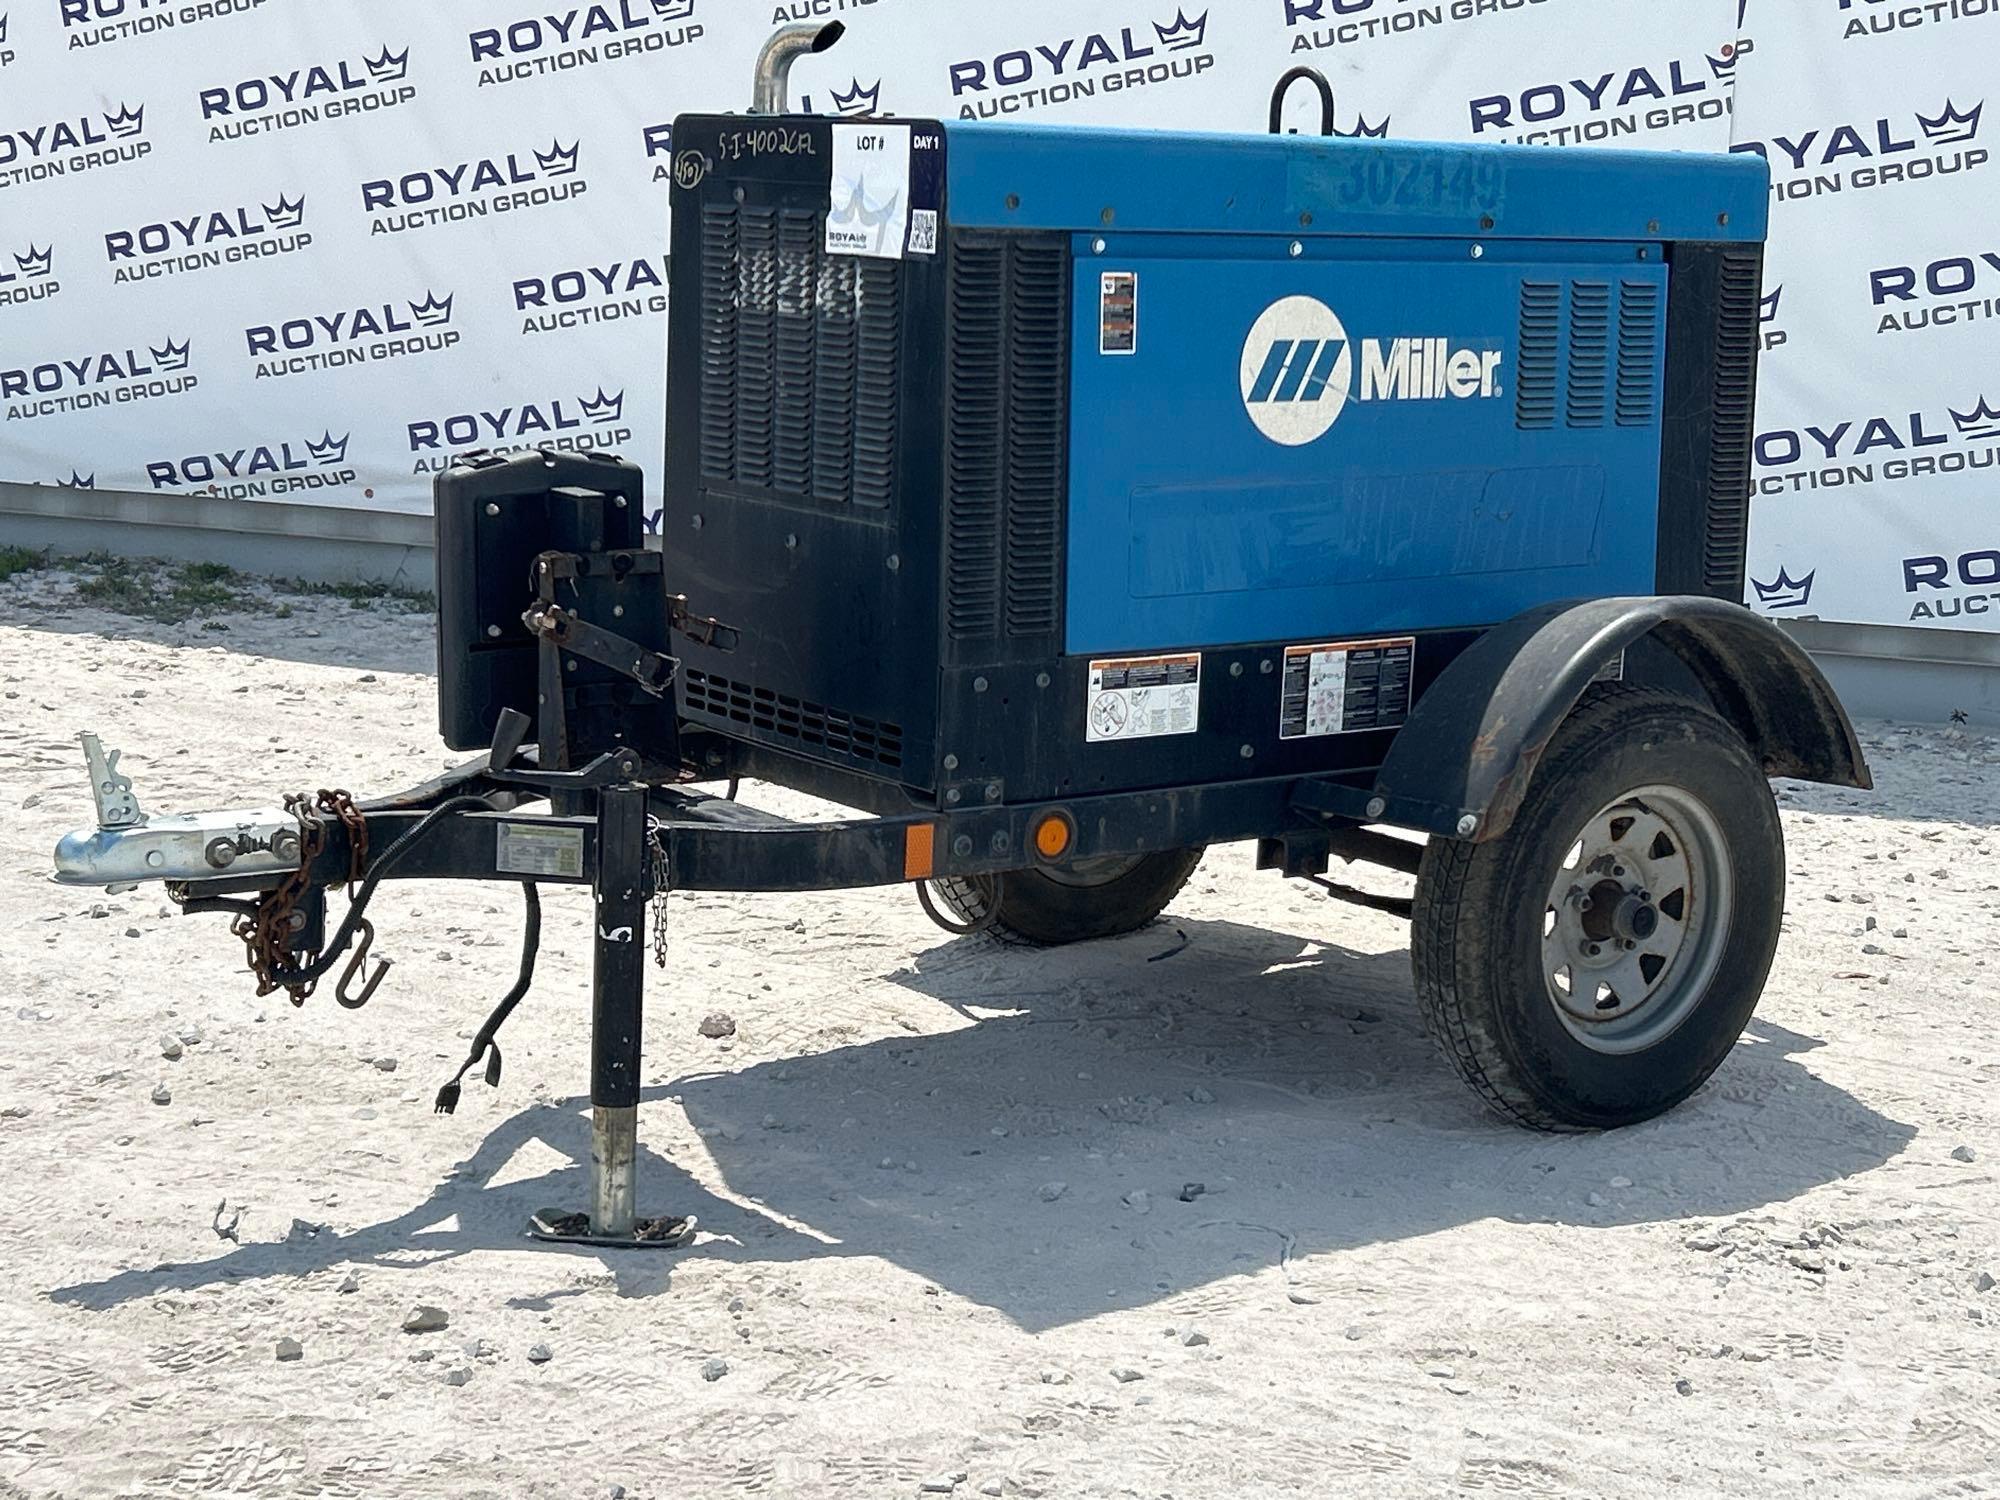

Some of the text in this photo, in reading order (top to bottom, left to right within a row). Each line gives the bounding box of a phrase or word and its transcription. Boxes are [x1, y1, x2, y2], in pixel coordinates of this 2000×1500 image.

[69, 12, 174, 50] AUCTION
[469, 0, 649, 62] ROYAL
[1291, 6, 1442, 53] AUCTION
[479, 25, 703, 87] AUCTION GROUP
[950, 28, 1153, 95] ROYAL
[200, 61, 366, 119] ROYAL
[960, 55, 1213, 120] AUCTION GROUP
[1470, 61, 1706, 133] ROYAL
[209, 86, 415, 143] AUCTION GROUP
[70, 142, 151, 171] GROUP
[856, 135, 876, 151] LOT
[913, 135, 939, 149] DAY 1
[362, 155, 535, 212] ROYAL
[1851, 150, 1988, 188] GROUP
[372, 181, 586, 235] AUCTION GROUP
[105, 208, 264, 262] ROYAL
[115, 234, 312, 284] AUCTION GROUP
[246, 305, 411, 356] ROYAL
[523, 299, 642, 334] AUCTION
[2, 350, 152, 398] ROYAL
[256, 331, 459, 379] AUCTION GROUP
[1360, 337, 1502, 400] Miller
[7, 376, 197, 421] AUCTION GROUP
[408, 401, 580, 451] ROYAL
[146, 443, 307, 489] ROYAL
[271, 470, 356, 493] GROUP
[1883, 448, 2000, 479] GROU
